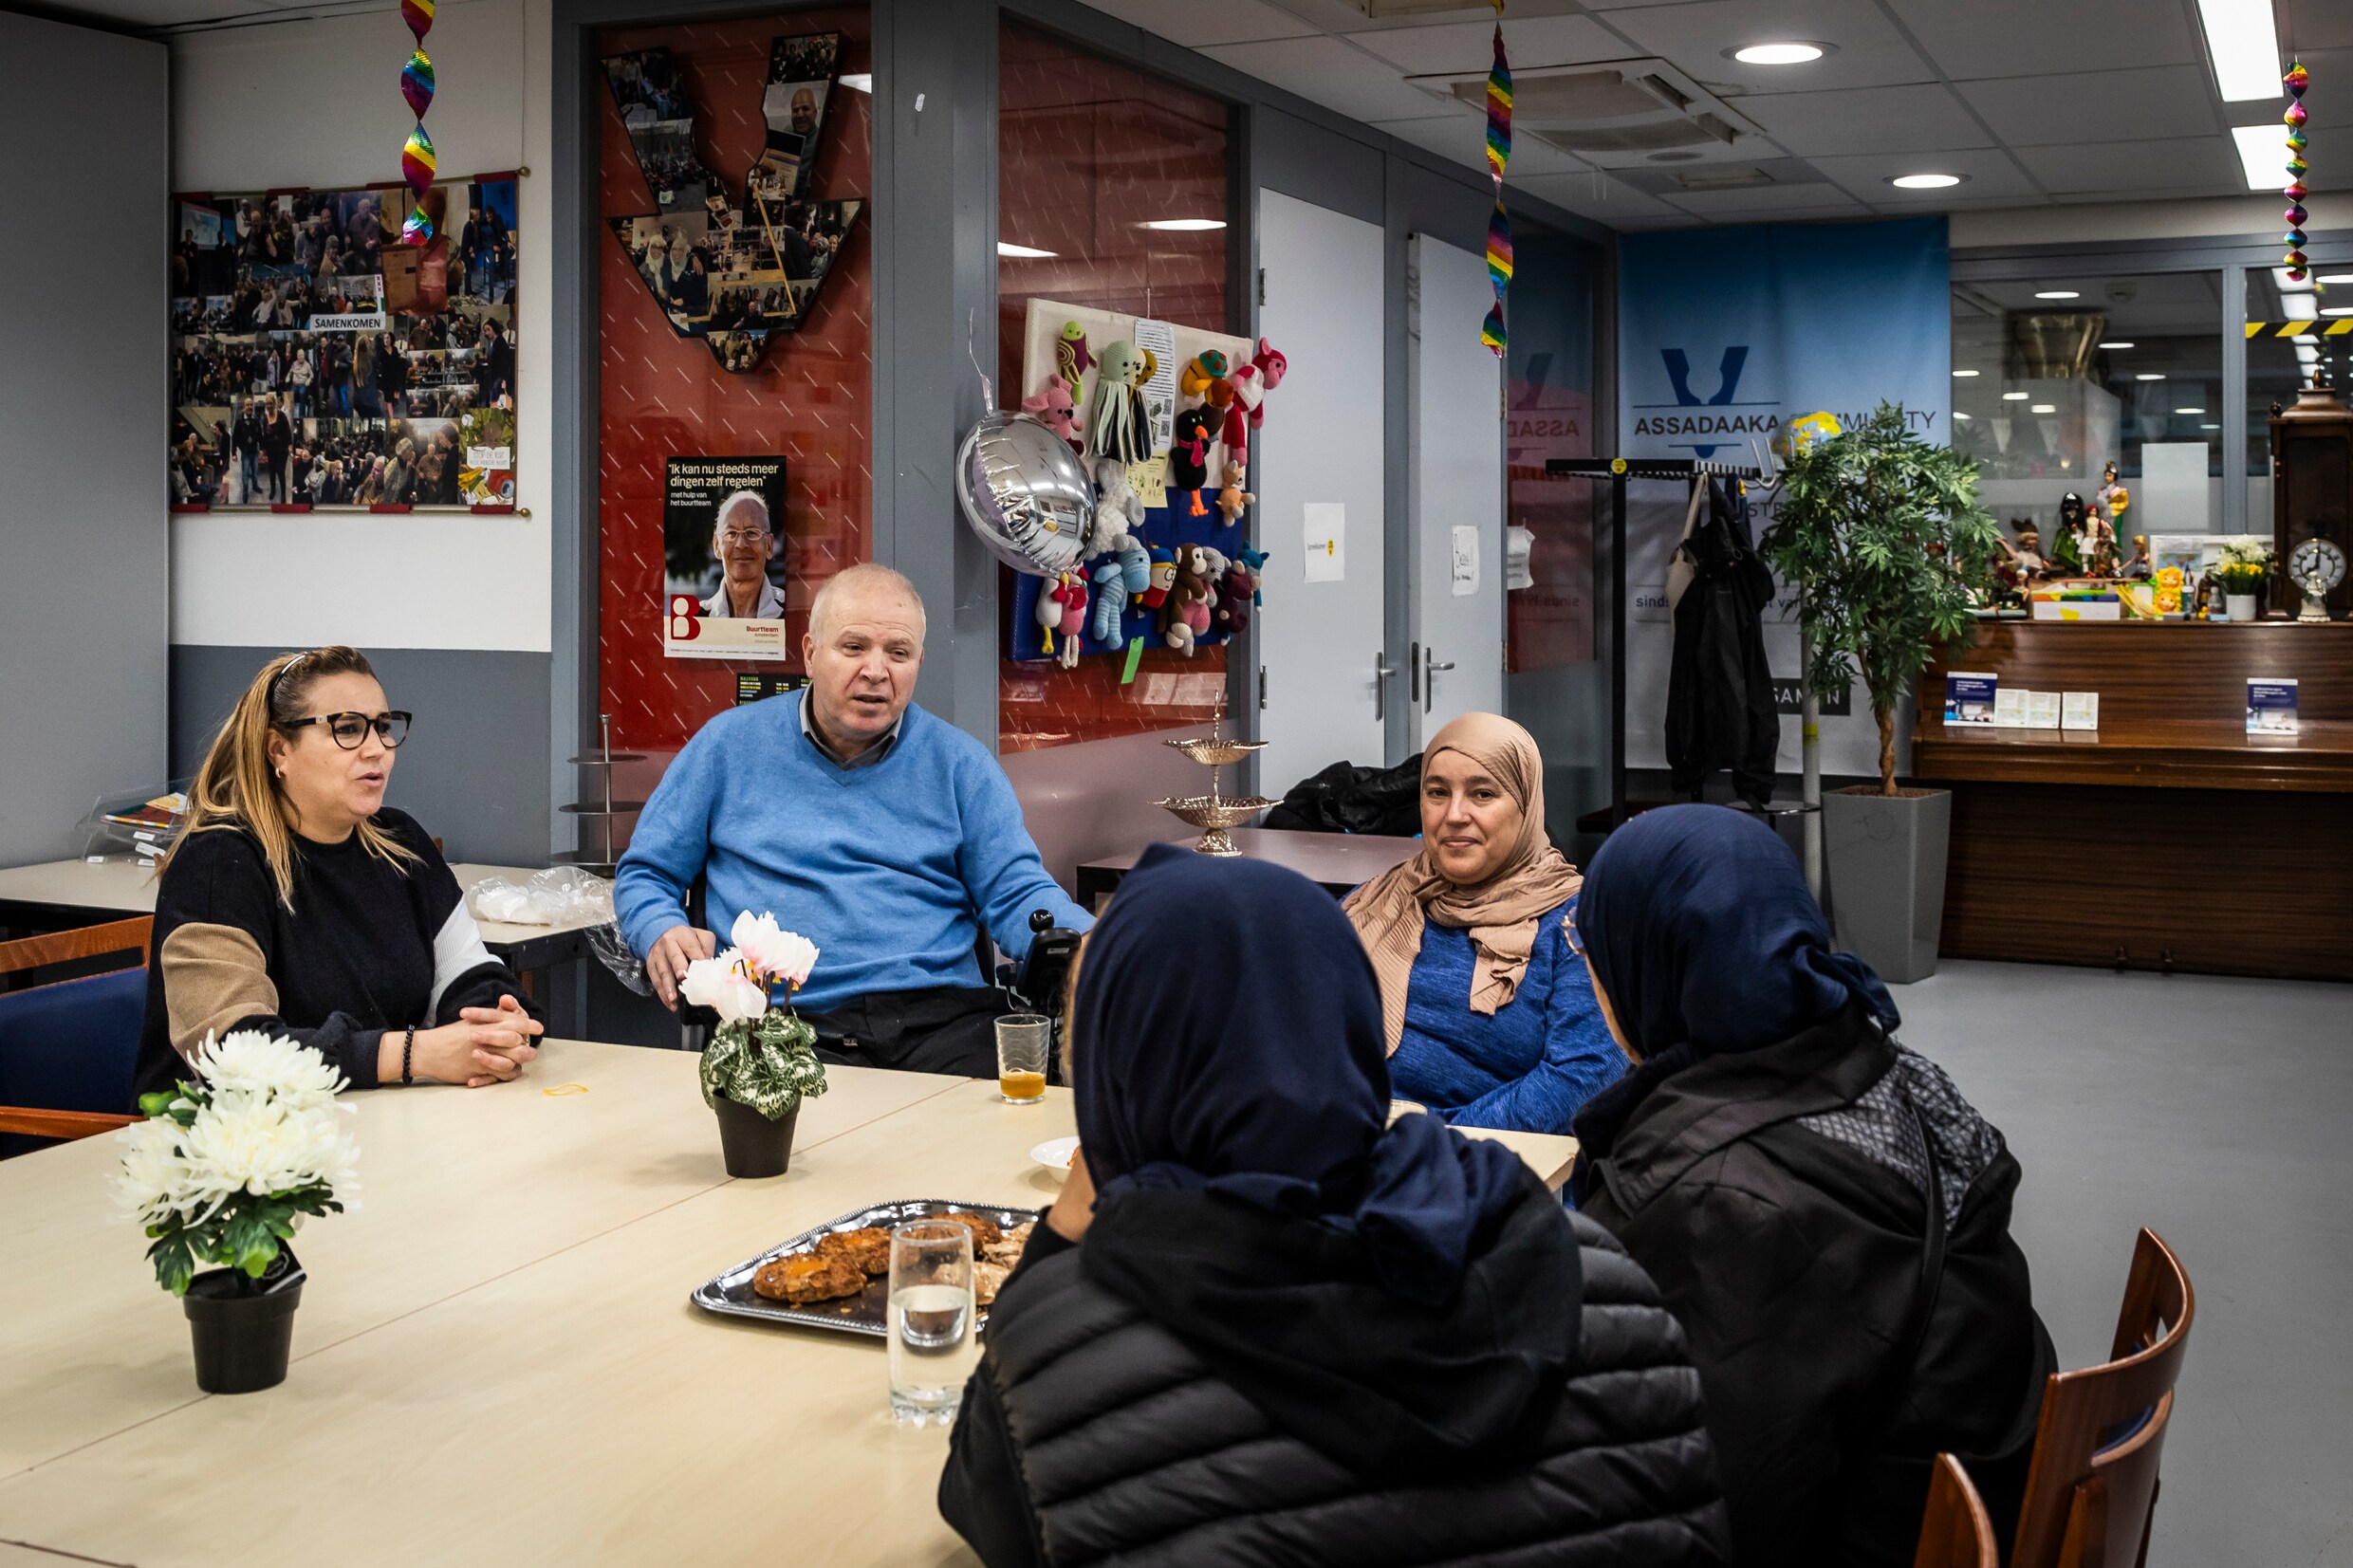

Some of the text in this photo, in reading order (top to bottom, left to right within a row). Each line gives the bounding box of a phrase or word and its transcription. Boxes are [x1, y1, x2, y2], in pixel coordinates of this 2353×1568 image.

[315, 318, 380, 328] SAMENKOMEN
[1635, 415, 1779, 435] ASSADAAKA
[682, 464, 700, 474] kan
[702, 465, 714, 474] nu
[716, 464, 750, 474] steeds
[751, 465, 779, 474] meer
[670, 475, 704, 489] dingen
[706, 476, 724, 487] zelf
[670, 594, 701, 640] B
